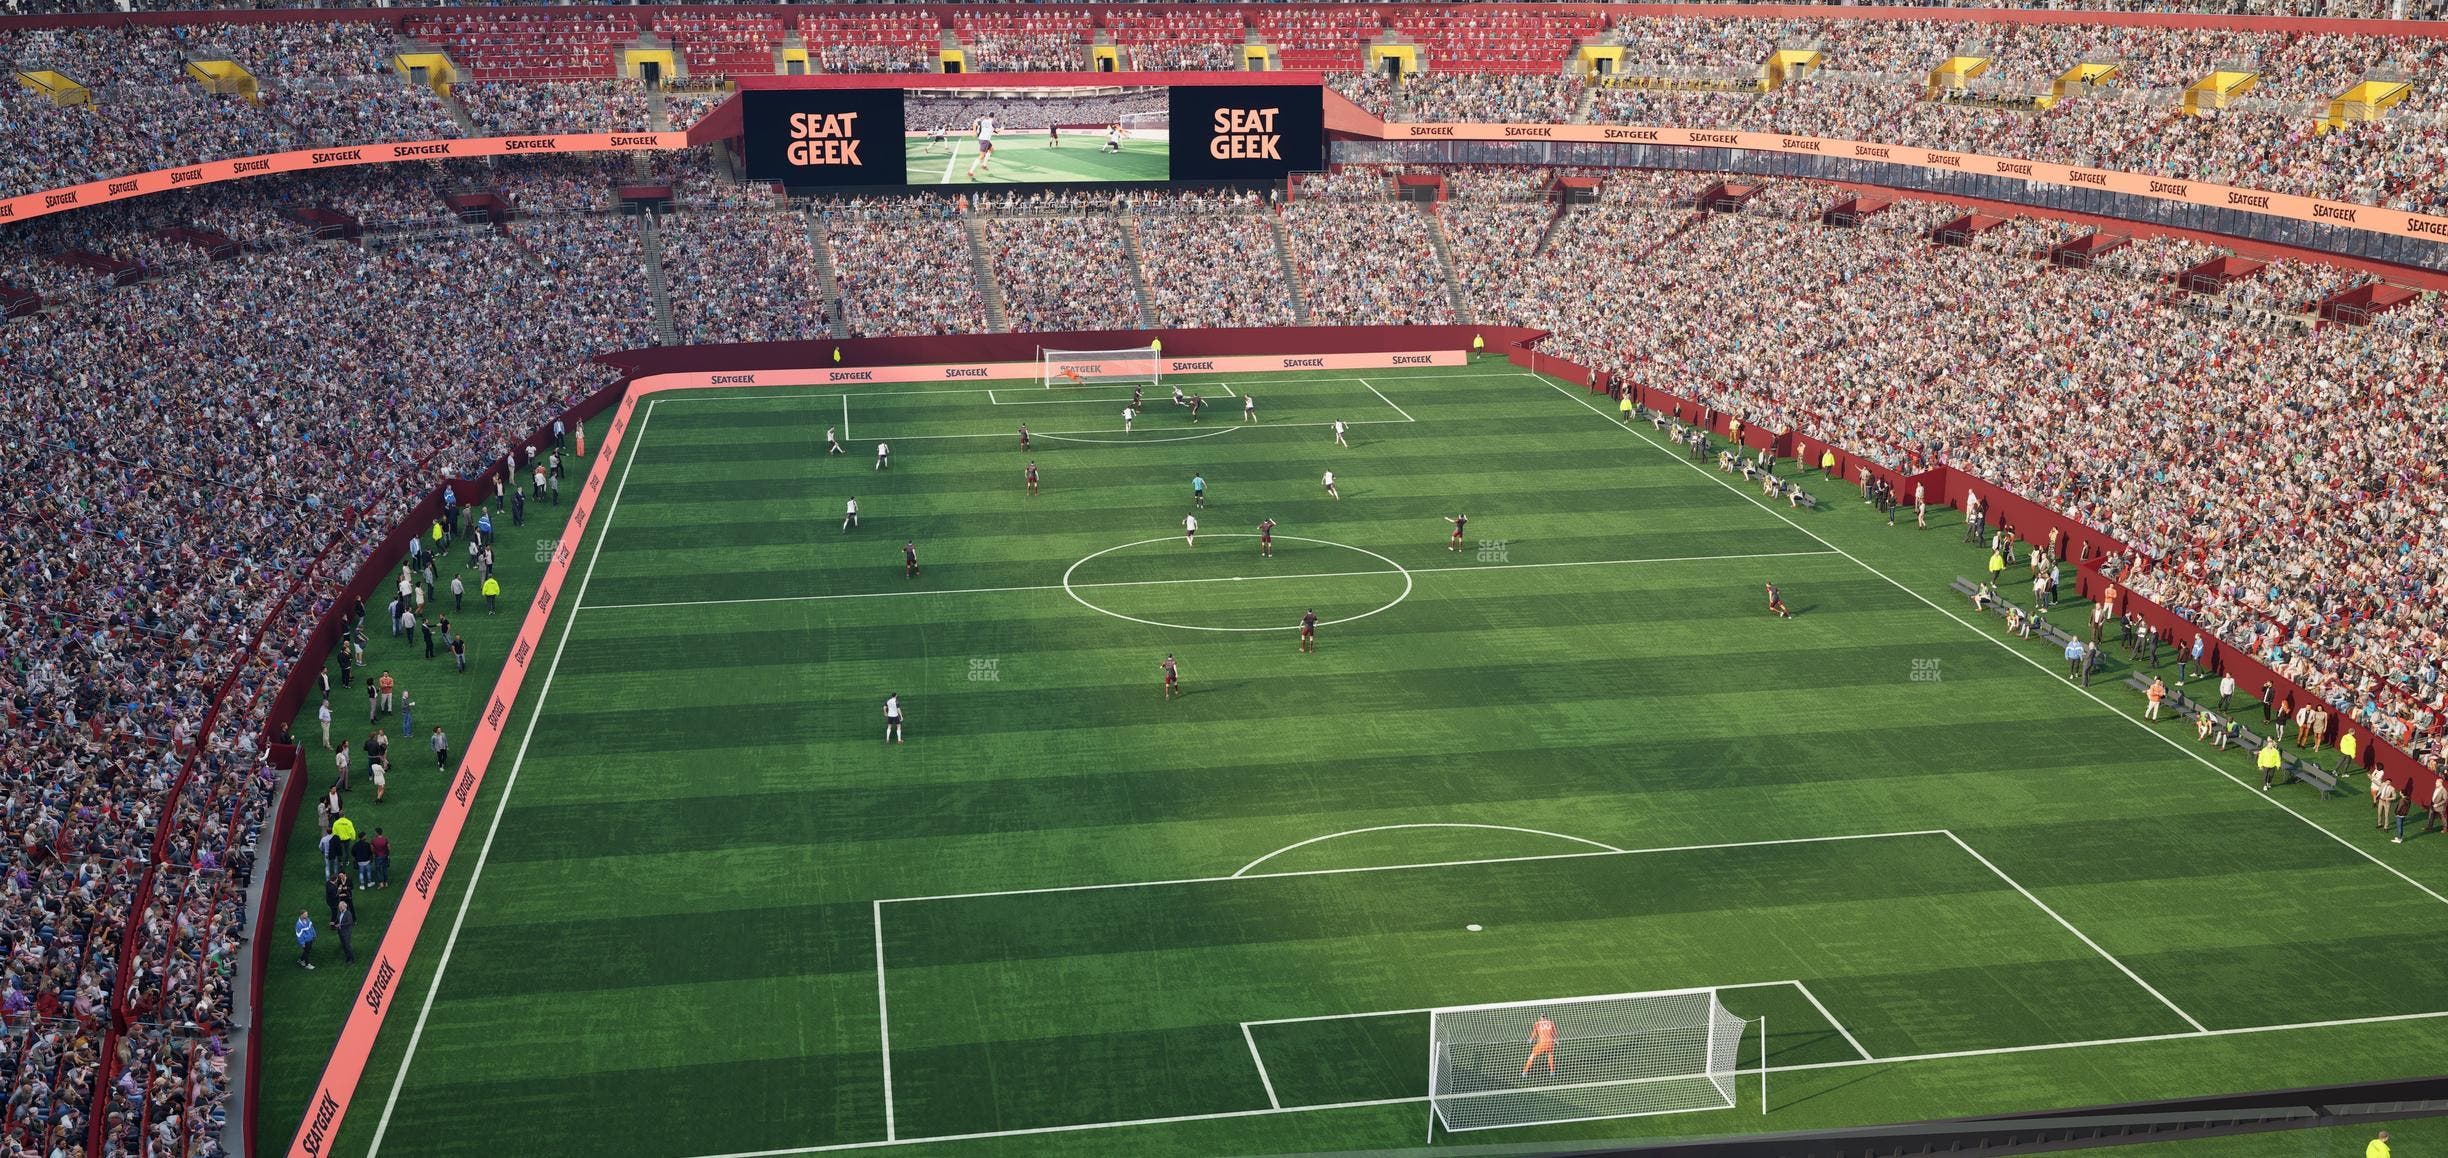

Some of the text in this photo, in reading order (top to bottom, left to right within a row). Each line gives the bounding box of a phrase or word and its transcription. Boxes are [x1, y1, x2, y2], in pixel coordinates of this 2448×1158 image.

[790, 112, 857, 139] SEAT
[1214, 108, 1279, 134] SEAT
[1410, 127, 1453, 136] SEATGEEK
[1505, 127, 1551, 136] SEATGEEK
[1604, 129, 1658, 140] SEATGEEK
[1689, 132, 1738, 144] SEATGEEK
[505, 139, 556, 150] SEATGEEK
[610, 136, 658, 147] SEATGEEK
[1210, 134, 1281, 160] GEEK
[1782, 138, 1821, 151] SEATGEEK
[312, 150, 361, 164] SEATGEEK
[393, 144, 450, 157] SEATGEEK
[788, 139, 862, 166] GEEK
[1855, 145, 1890, 159] SEATGEEK
[233, 159, 270, 174] SEATGEEK
[1927, 153, 1960, 167] SEATGEEK
[170, 168, 203, 184] SEATGEEK
[1997, 161, 2032, 176] SEATGEEK
[2069, 171, 2106, 186] SEATGEEK
[108, 179, 138, 196] SEATGEEK
[2150, 181, 2187, 198] SEATGEEK
[45, 191, 78, 208] SEATGEEK
[2228, 192, 2269, 209] SEATGEEK
[2313, 204, 2356, 223] SEATGEEK
[2407, 218, 2448, 237] SEATGEE
[1173, 362, 1213, 371] SEATGEEK
[1283, 358, 1324, 368] SEATGEEK
[1392, 355, 1432, 365] SEATGEEK
[711, 374, 755, 384] SEATGEEK
[829, 371, 872, 381] SEATGEEK
[945, 368, 988, 378] SEATGEEK
[455, 766, 476, 807] SEATGEEK
[415, 850, 440, 900] SEATGEEK
[366, 955, 396, 1015] SEATGEEK
[303, 1087, 340, 1158] SEATGEEK
